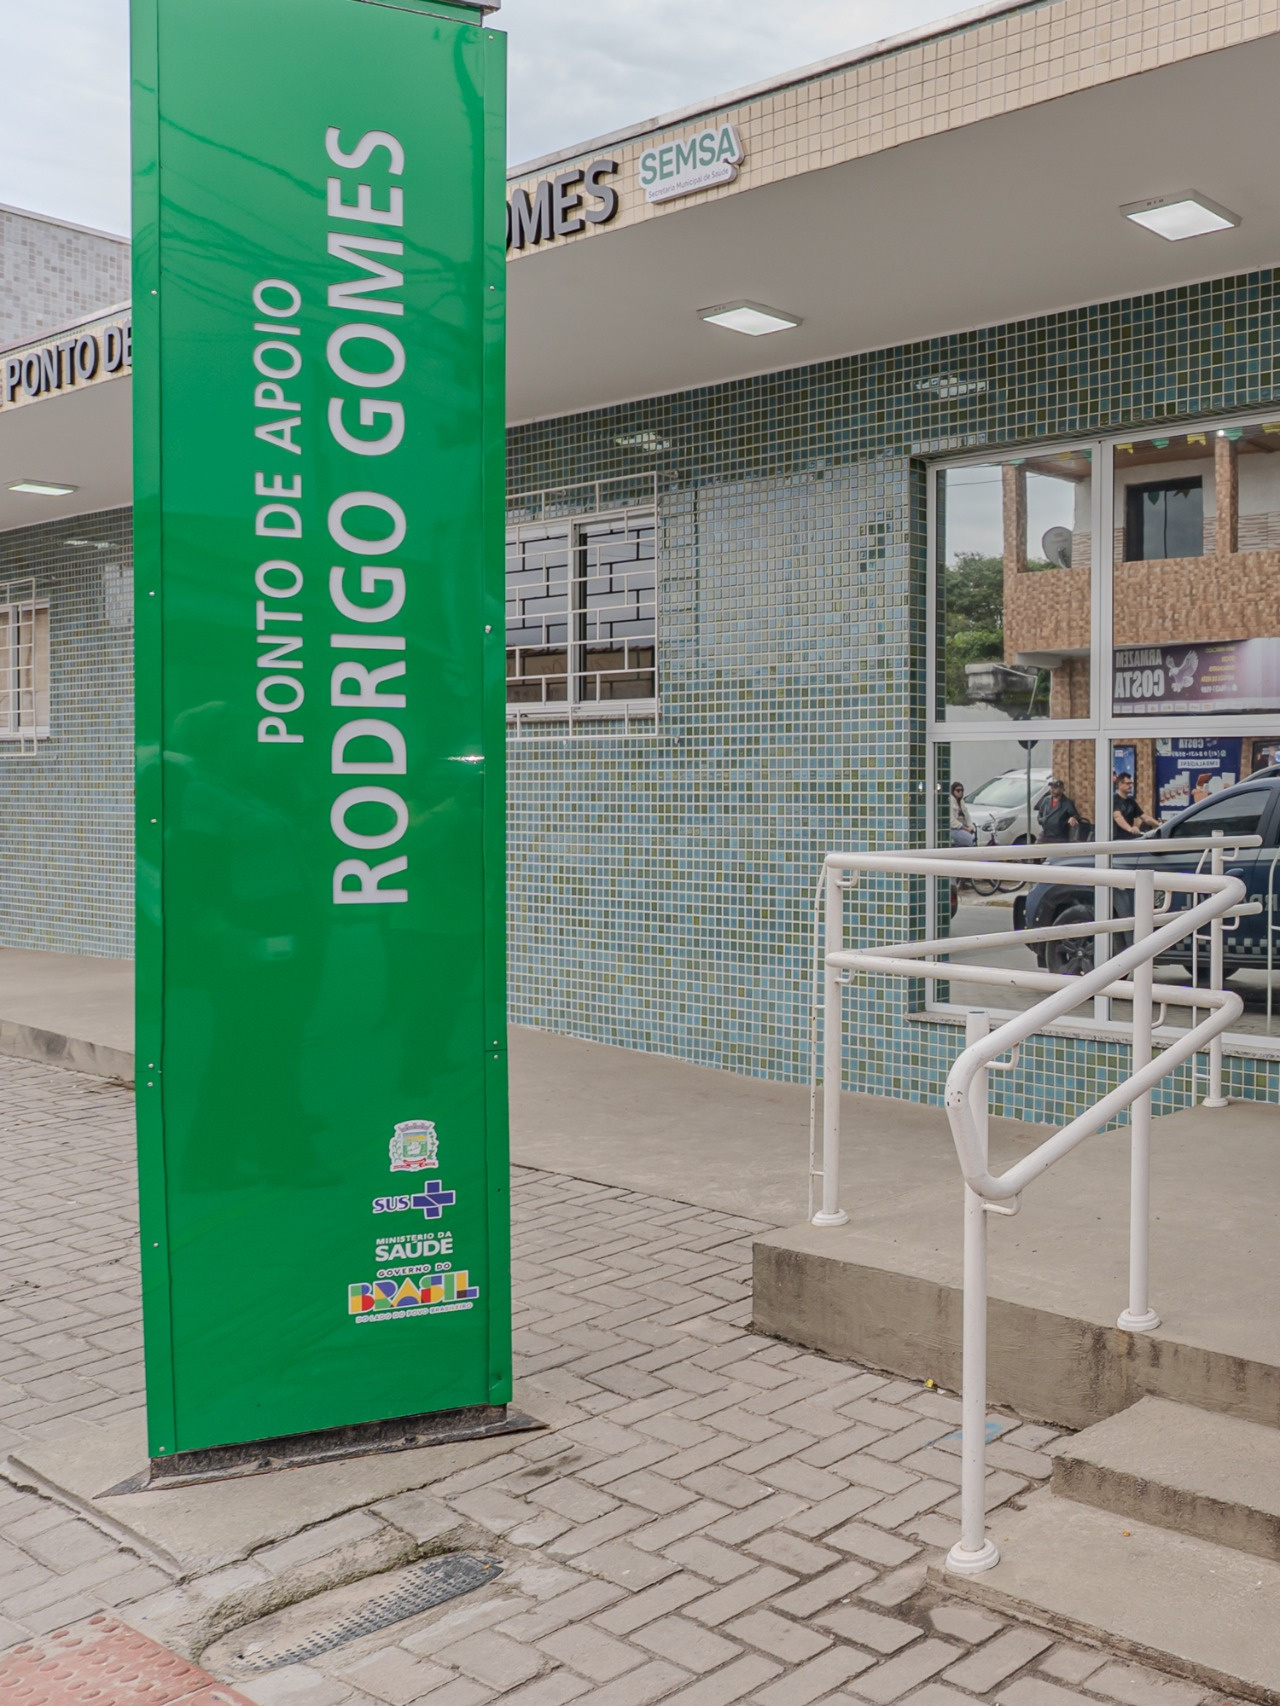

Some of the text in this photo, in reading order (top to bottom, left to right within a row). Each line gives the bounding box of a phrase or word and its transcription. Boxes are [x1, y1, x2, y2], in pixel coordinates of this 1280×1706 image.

[641, 127, 737, 185] SEMSA
[648, 168, 729, 199] Secretaria Municipal de Saúde
[6, 333, 97, 401] PONTO
[506, 159, 618, 250] MES
[252, 278, 305, 743] PONTO DE APOIO
[325, 127, 409, 904] RODRIGO GOMES
[373, 1196, 409, 1213] SUS
[375, 1238, 453, 1262] SAÚDE
[437, 1230, 453, 1239] DA
[377, 1262, 451, 1278] GOVERNO DO
[348, 1270, 480, 1315] BRASIL
[370, 1311, 392, 1322] LADO
[393, 1310, 406, 1319] DO
[407, 1307, 429, 1317] POVO
[430, 1302, 474, 1314] BRASILEIRO
